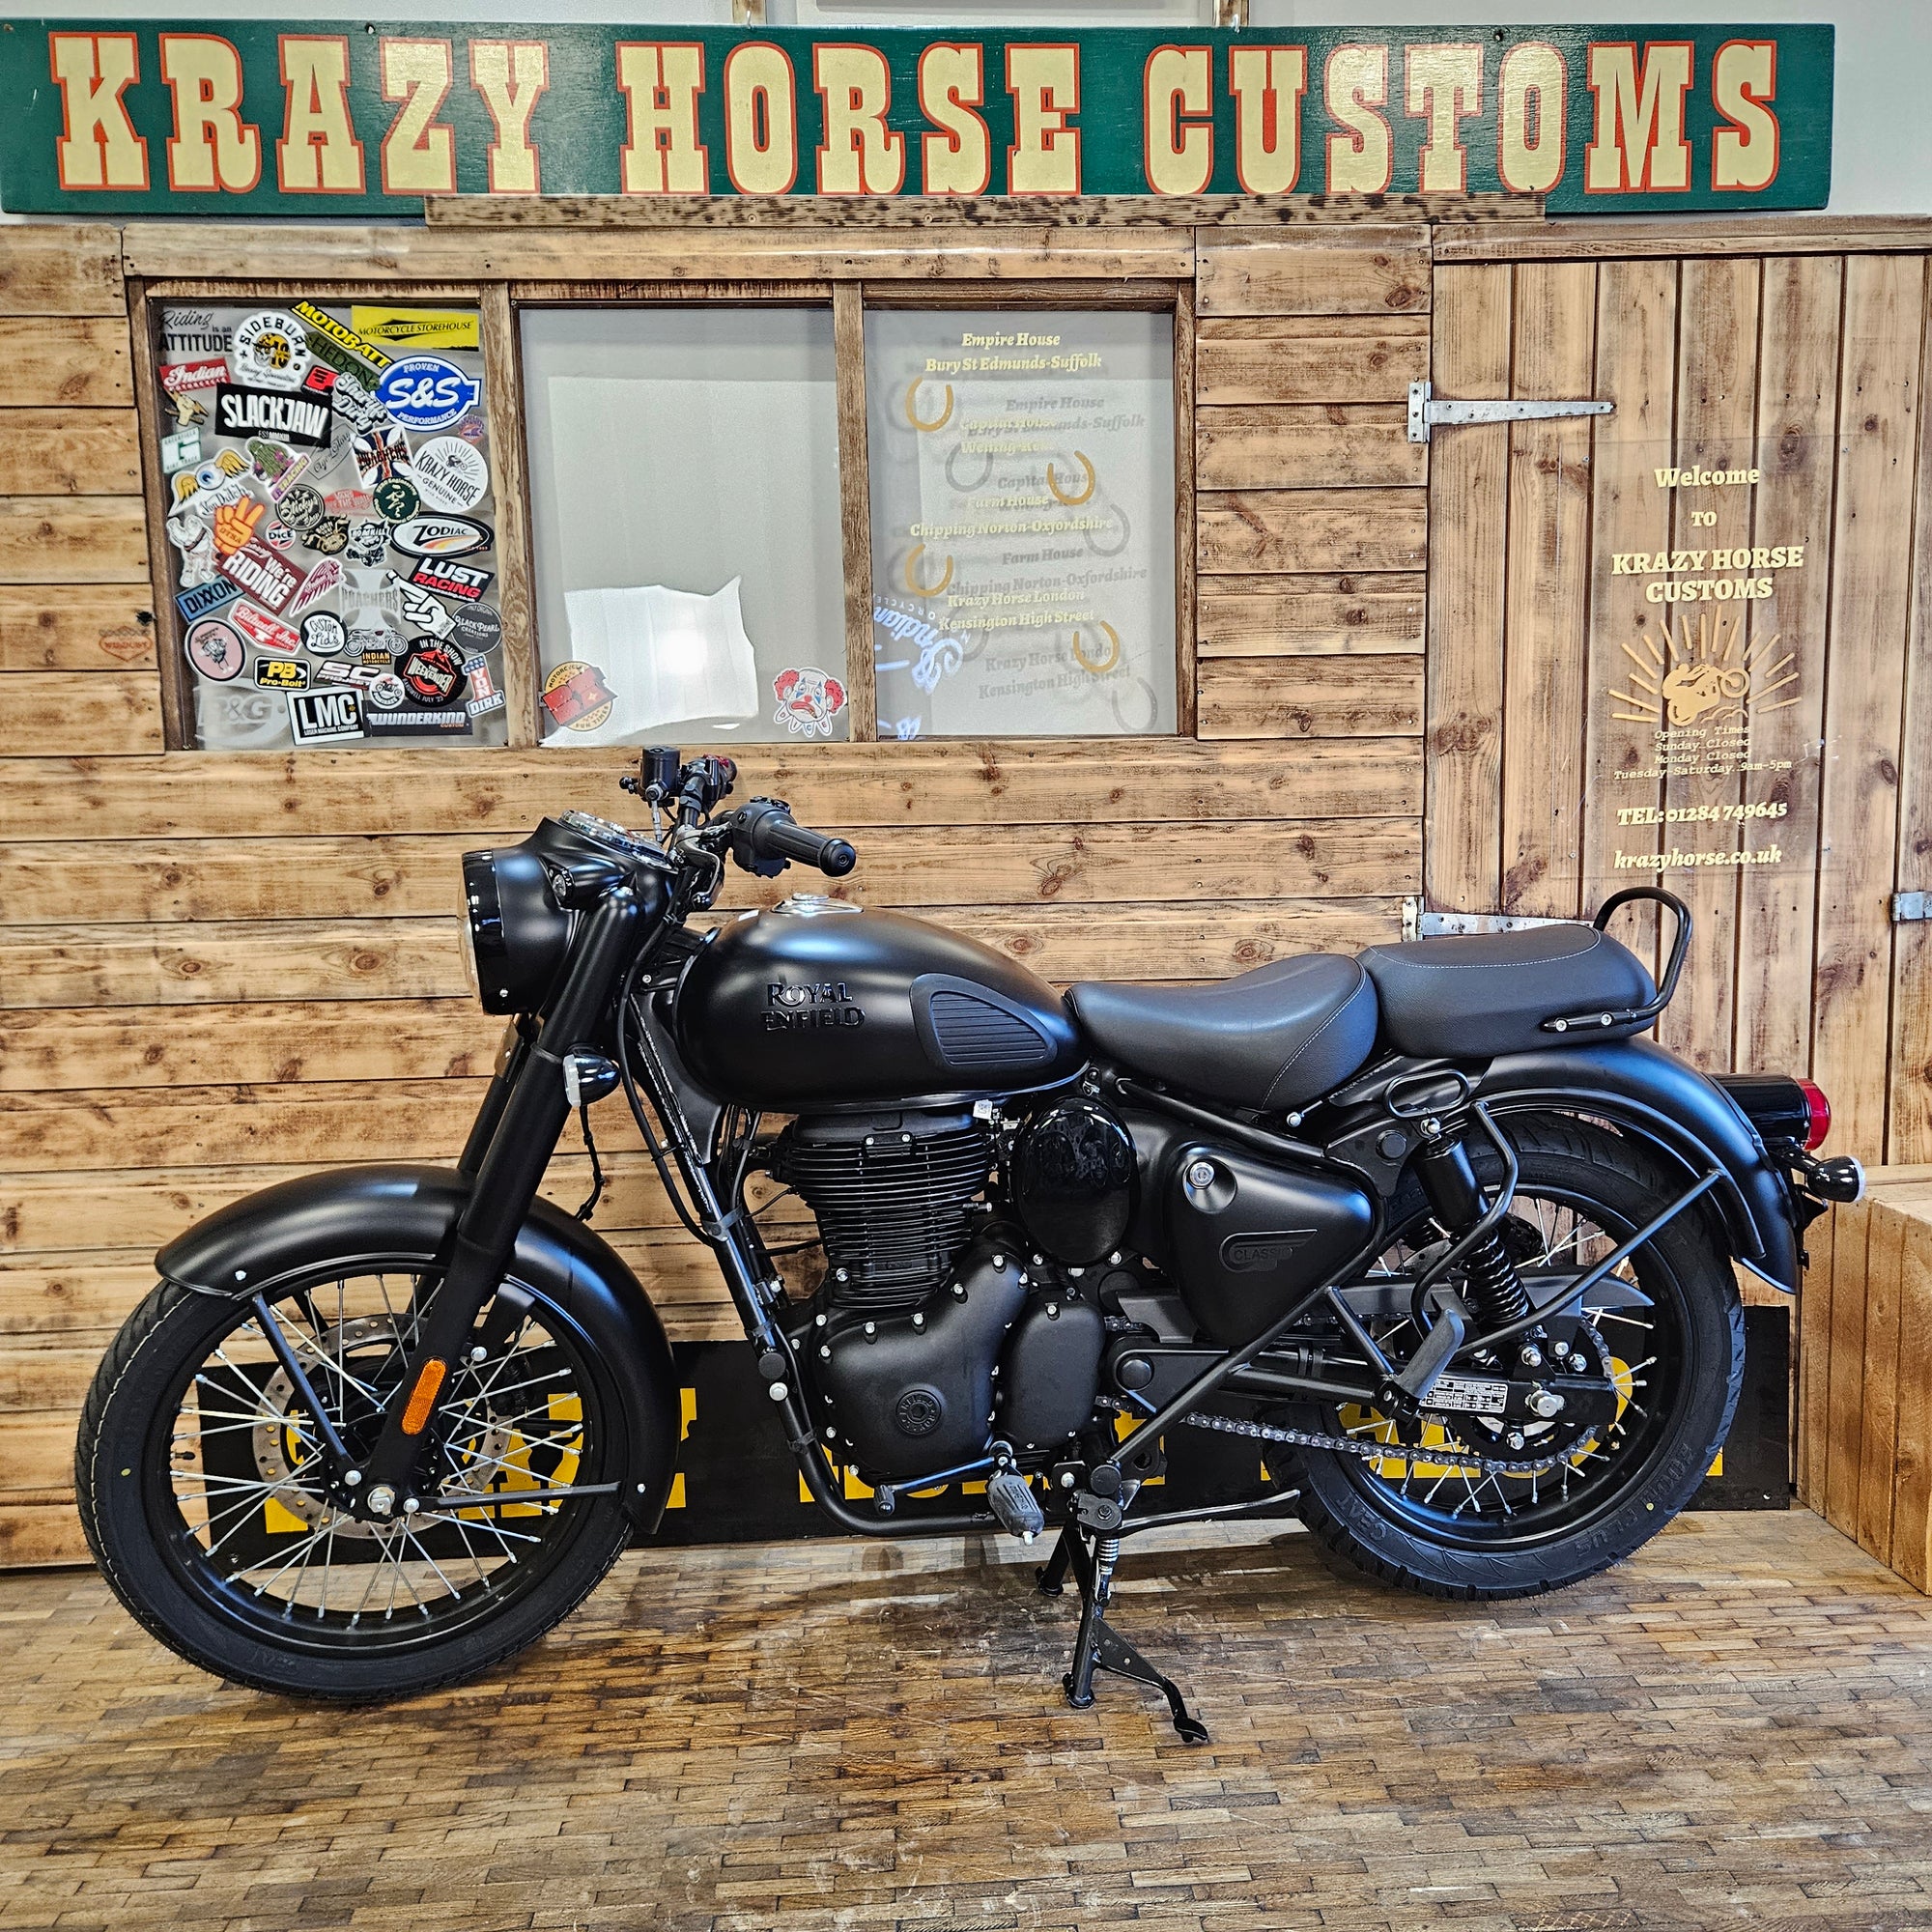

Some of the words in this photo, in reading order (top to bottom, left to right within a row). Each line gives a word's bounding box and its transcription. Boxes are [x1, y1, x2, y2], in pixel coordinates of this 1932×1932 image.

[48, 32, 549, 195] KRAZY
[615, 41, 1081, 195] HORSE
[1144, 39, 1782, 194] CUSTOMS
[159, 309, 213, 329] Riding
[358, 325, 415, 337] MOTORCYCLE
[416, 321, 472, 332] STOREHOUSE
[158, 333, 233, 353] ATTITUDE
[239, 316, 306, 357] SIDEBURN
[296, 300, 393, 368] MOTORBATT
[961, 331, 1015, 351] Empire
[1016, 330, 1061, 348] House
[163, 364, 227, 386] Indian
[403, 362, 440, 374] PROVEN
[925, 358, 962, 376] Bury
[962, 357, 979, 372] St
[980, 353, 1102, 373] Edmunds-Suffolk
[386, 377, 462, 410] S&S
[221, 393, 329, 439] SLACKJAW
[1006, 397, 1059, 414] Empire
[1061, 396, 1105, 410] House
[397, 408, 458, 426] PERFORMANCE
[415, 450, 450, 482] KRAZY
[446, 474, 481, 507] HORSE
[1654, 465, 1760, 488] Welcome
[422, 477, 458, 504] GENUINE
[1001, 494, 1050, 508] House
[910, 523, 977, 542] Chipping
[978, 516, 1113, 538] Norton-Oxfordshire
[1691, 511, 1718, 527] TO
[412, 525, 469, 547] ZODIAC
[1002, 552, 1040, 566] Farm
[1042, 548, 1084, 562] House
[1611, 550, 1708, 576] KRAZY
[1711, 546, 1804, 571] HORSE
[222, 550, 290, 608] RIDING
[265, 555, 298, 588] We're
[418, 556, 489, 587] LUST
[184, 578, 238, 614] DIXXON
[412, 572, 482, 598] RACING
[1645, 577, 1774, 603] CUSTOMS
[947, 593, 995, 610] Krazy
[995, 591, 1032, 606] Horse
[1033, 588, 1086, 604] London
[310, 618, 338, 634] CUSTOM
[455, 615, 477, 629] BLACK
[477, 622, 500, 633] PEARL
[461, 626, 489, 638] CREATIONS
[938, 613, 1018, 633] Kensington
[1018, 613, 1053, 628] High
[1054, 609, 1095, 623] Street
[311, 632, 340, 649] Lids
[419, 639, 429, 648] IN
[430, 639, 444, 650] THE
[443, 644, 464, 667] SHOW
[985, 657, 1027, 673] Krazy
[1029, 652, 1067, 668] Horse
[267, 662, 298, 679] PB
[317, 661, 381, 681] SC
[407, 657, 454, 693] WEEKENDER
[259, 677, 304, 688] Pro-Bolt
[470, 668, 492, 698] VON
[979, 680, 1056, 700] Kensington
[298, 693, 357, 730] LMC
[469, 692, 504, 716] DIRK
[366, 711, 467, 726] WUNDERKIND
[1654, 728, 1707, 742] Opening
[1714, 725, 1751, 734] Times
[1706, 738, 1751, 749] Closed
[1706, 750, 1751, 761] Closed
[1722, 801, 1788, 821] 749645
[1613, 844, 1782, 873] krazyhorse.co.uk
[767, 981, 853, 1007] ROYAL
[761, 1007, 866, 1031] ENFIELD
[1234, 1246, 1294, 1262] CLASSIC
